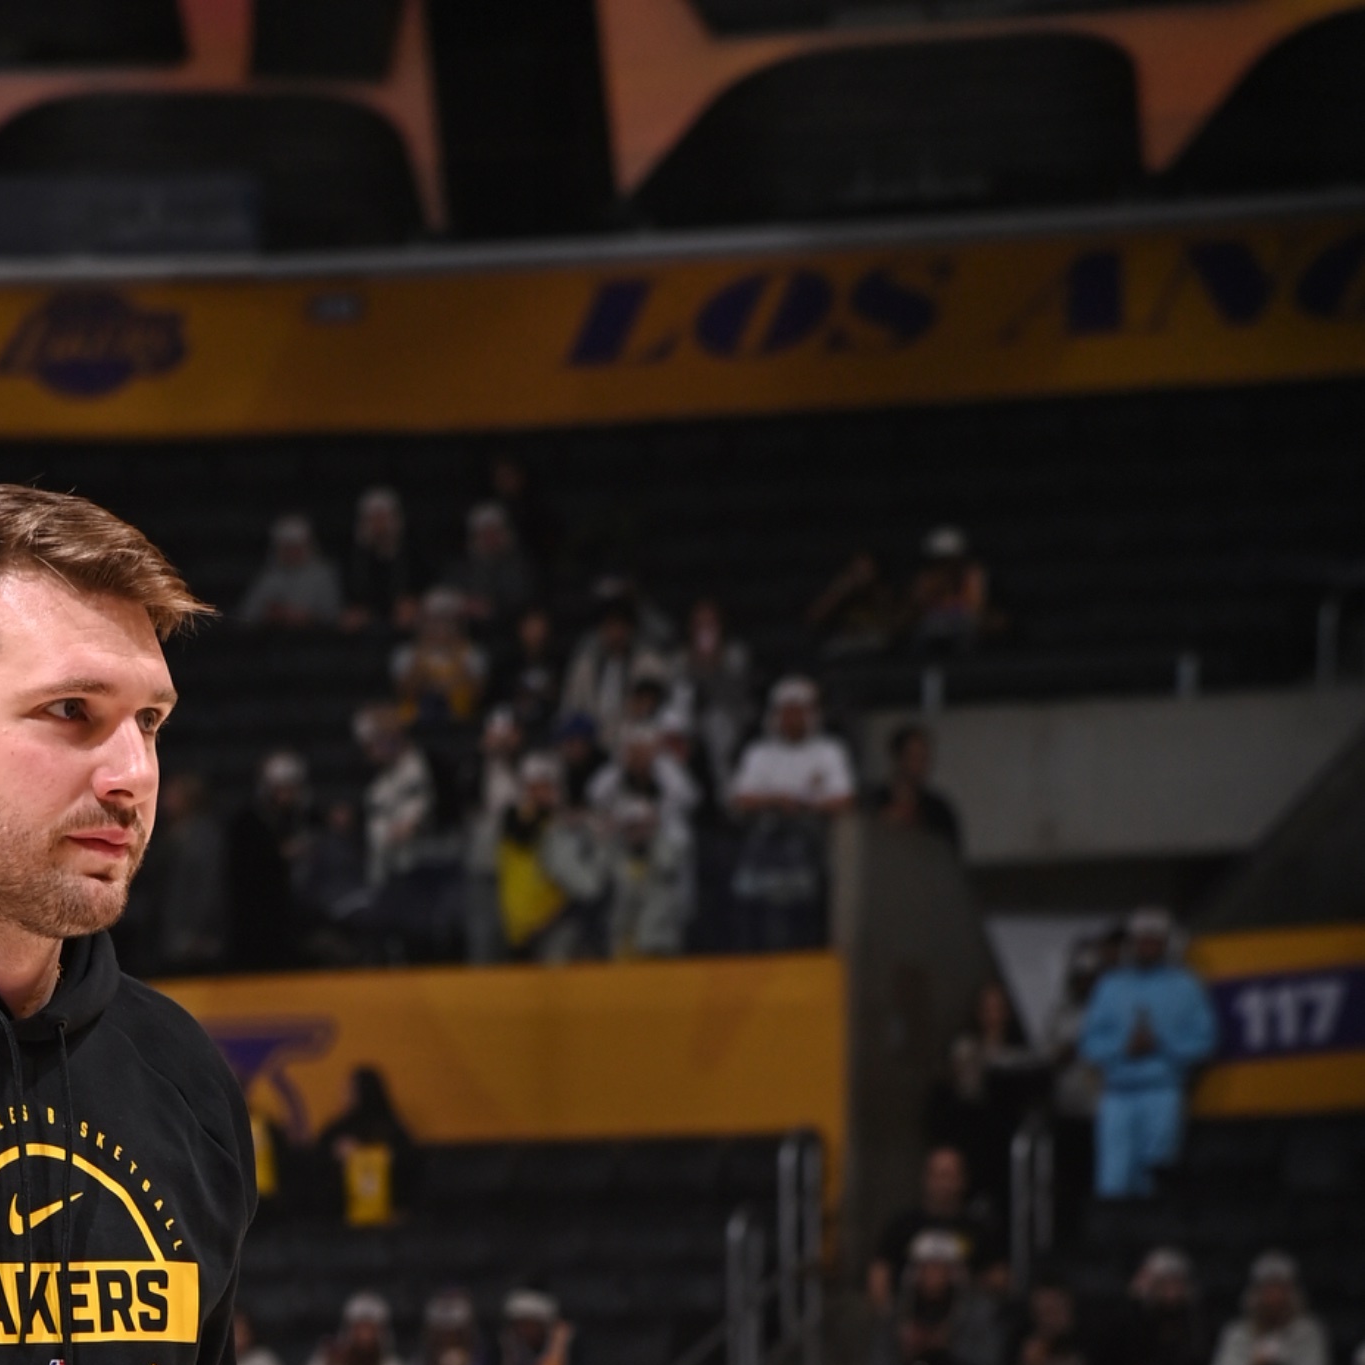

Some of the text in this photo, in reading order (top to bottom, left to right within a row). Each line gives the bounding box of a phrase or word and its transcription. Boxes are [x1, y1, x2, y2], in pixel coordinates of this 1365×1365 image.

[562, 257, 952, 369] LOS
[1234, 981, 1343, 1049] 117
[46, 1106, 183, 1252] BSKETBALL
